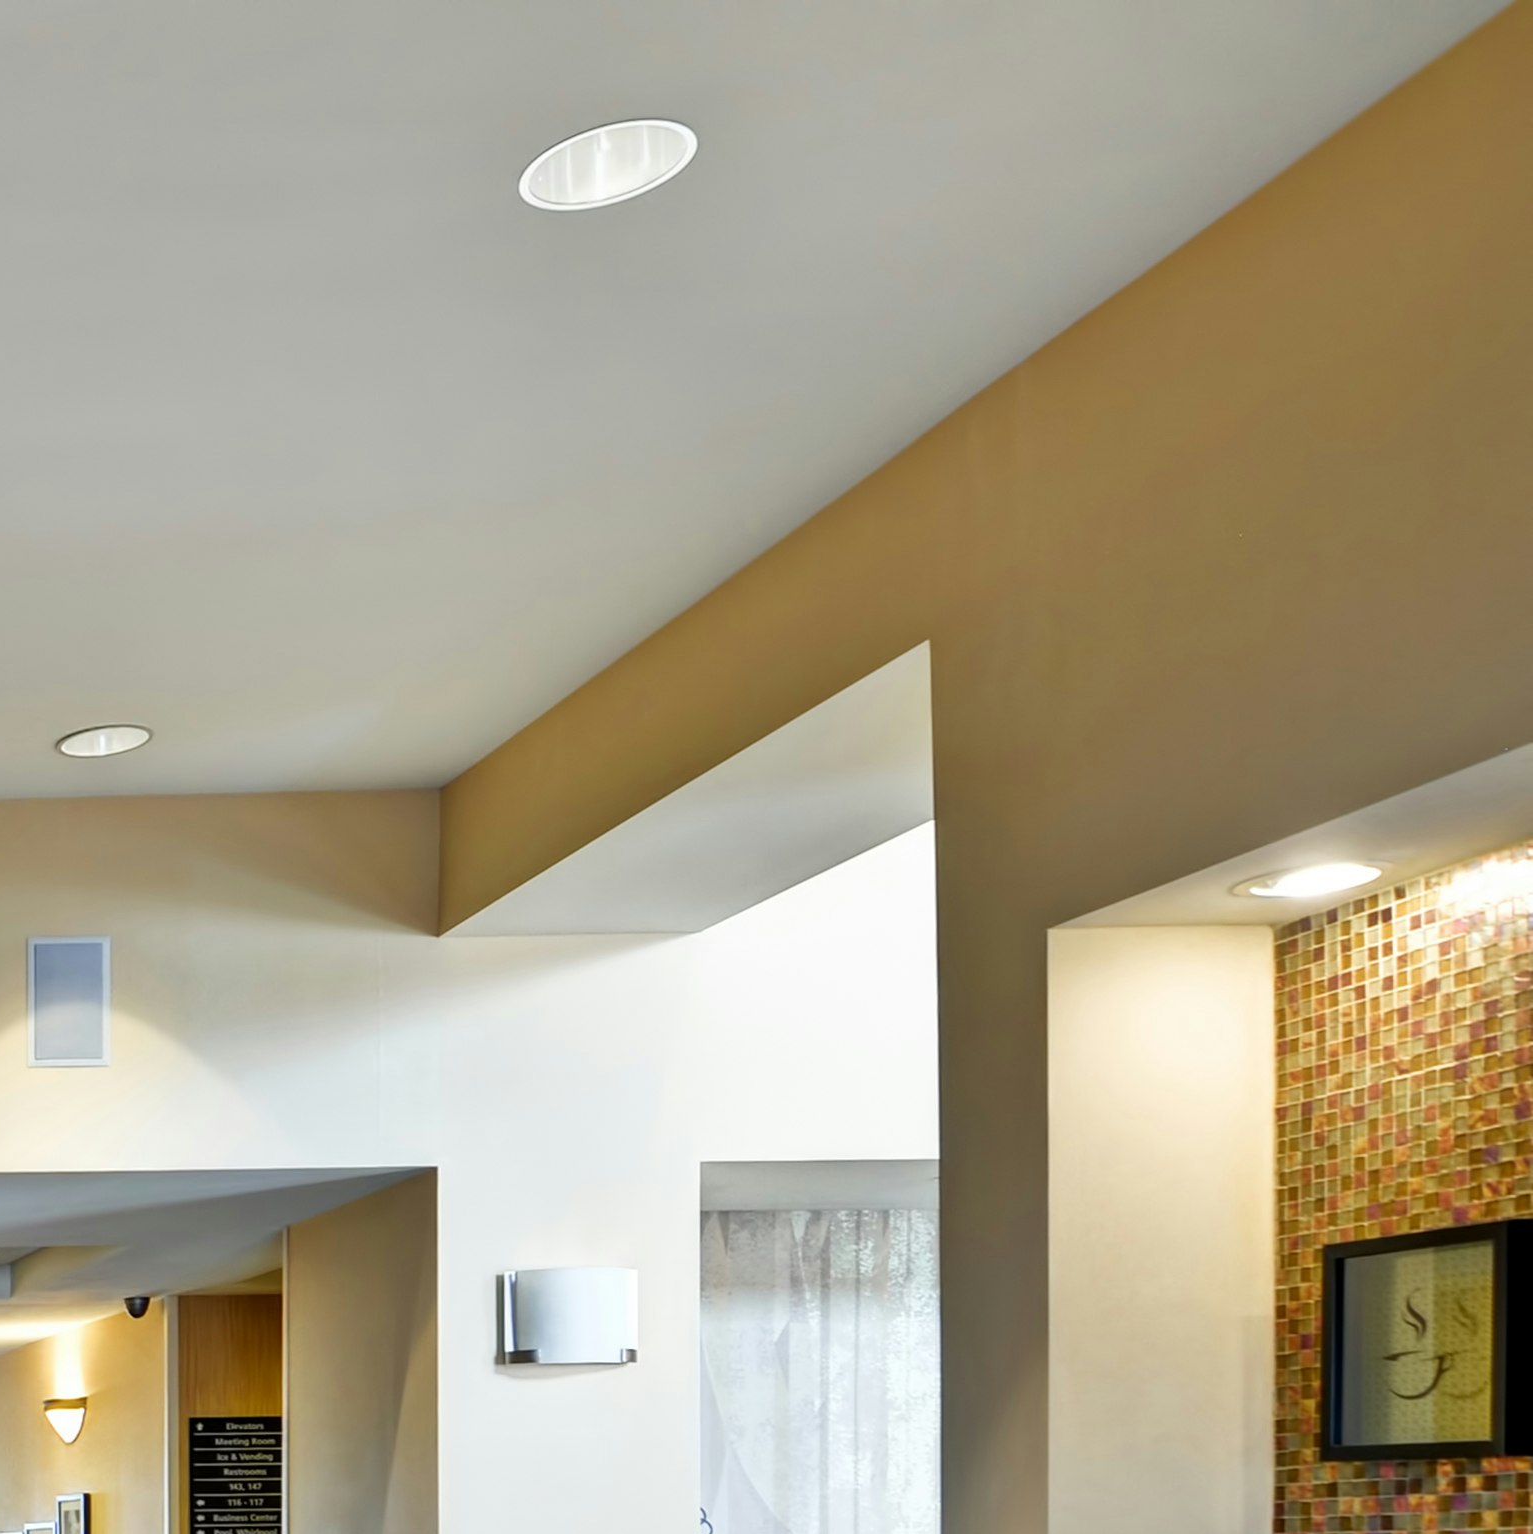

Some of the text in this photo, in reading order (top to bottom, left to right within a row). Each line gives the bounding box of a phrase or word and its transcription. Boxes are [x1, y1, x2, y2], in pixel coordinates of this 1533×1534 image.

[226, 1422, 264, 1430] Elevators
[215, 1437, 276, 1446] Meeting Room
[216, 1453, 229, 1461] Ice
[238, 1453, 274, 1462] Vending
[223, 1468, 267, 1476] Restrooms
[213, 1514, 249, 1522] Business
